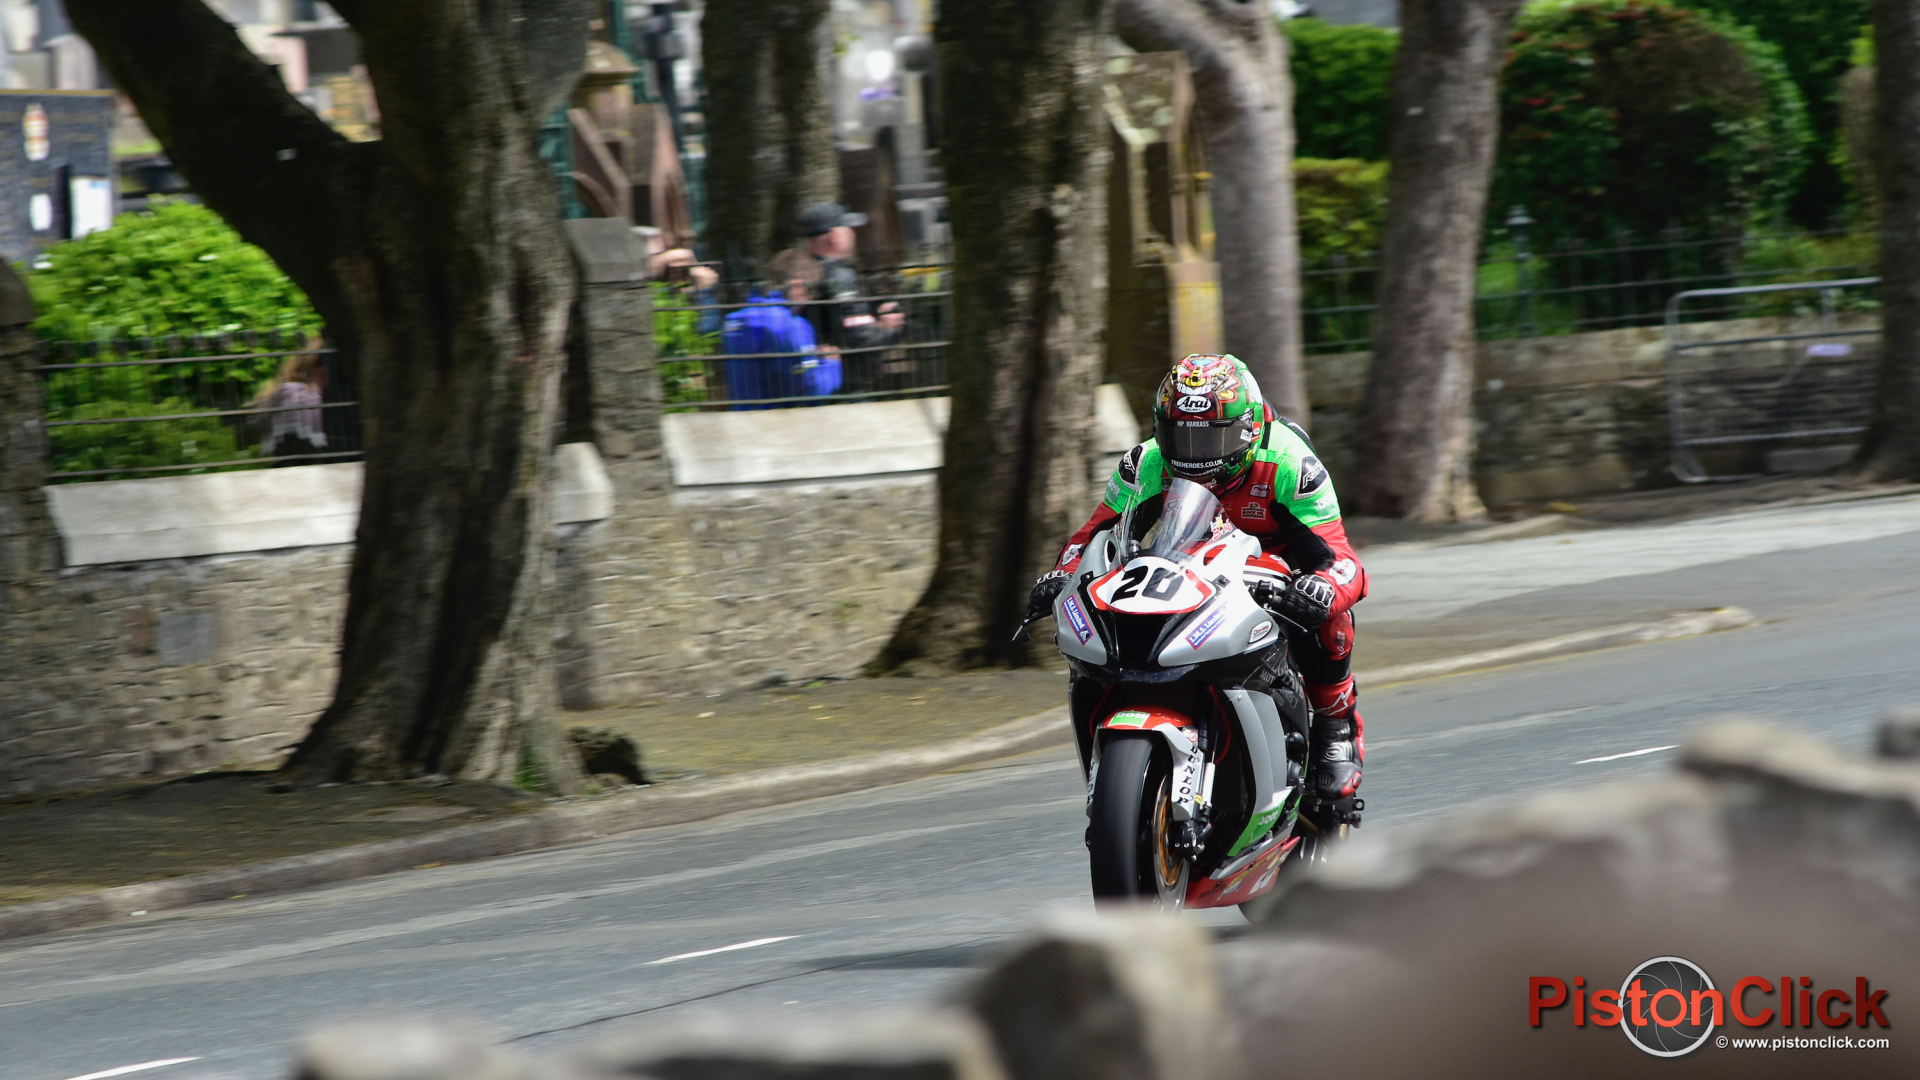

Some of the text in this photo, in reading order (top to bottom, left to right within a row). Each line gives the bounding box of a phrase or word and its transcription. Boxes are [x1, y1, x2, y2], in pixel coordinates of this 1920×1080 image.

[1177, 396, 1209, 409] Arai
[1186, 420, 1210, 428] BARRASS
[1171, 458, 1224, 469] TREEHEROES.CO.UK
[1110, 564, 1185, 605] 20
[1177, 744, 1198, 805] DUNLOP
